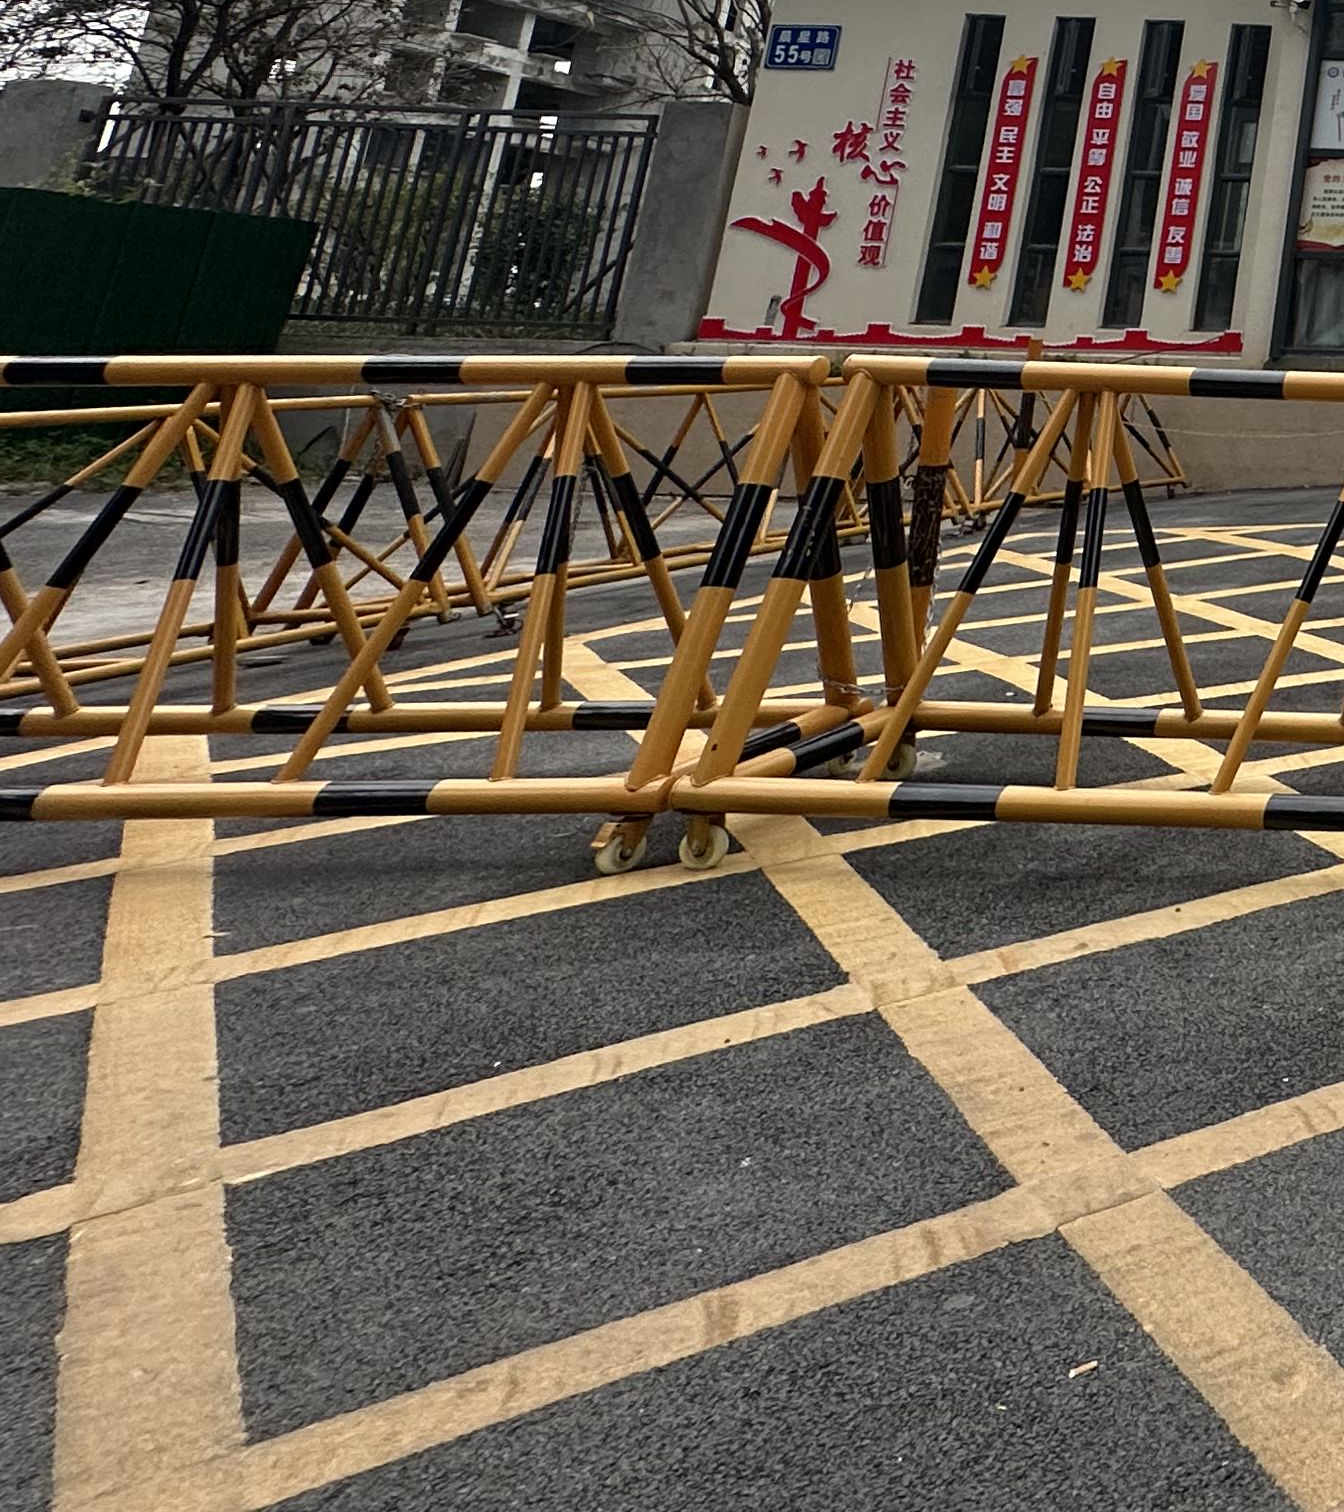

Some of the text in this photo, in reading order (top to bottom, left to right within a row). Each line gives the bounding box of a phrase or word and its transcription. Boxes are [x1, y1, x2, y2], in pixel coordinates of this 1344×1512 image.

[879, 59, 915, 152] 社会主义
[1095, 82, 1116, 119] 自由
[832, 121, 906, 185] 核心
[996, 126, 1019, 163] 民主
[987, 173, 1010, 211] 文明
[1080, 176, 1103, 214] 公正
[858, 194, 891, 266] 价值观
[1072, 224, 1096, 262] 法治
